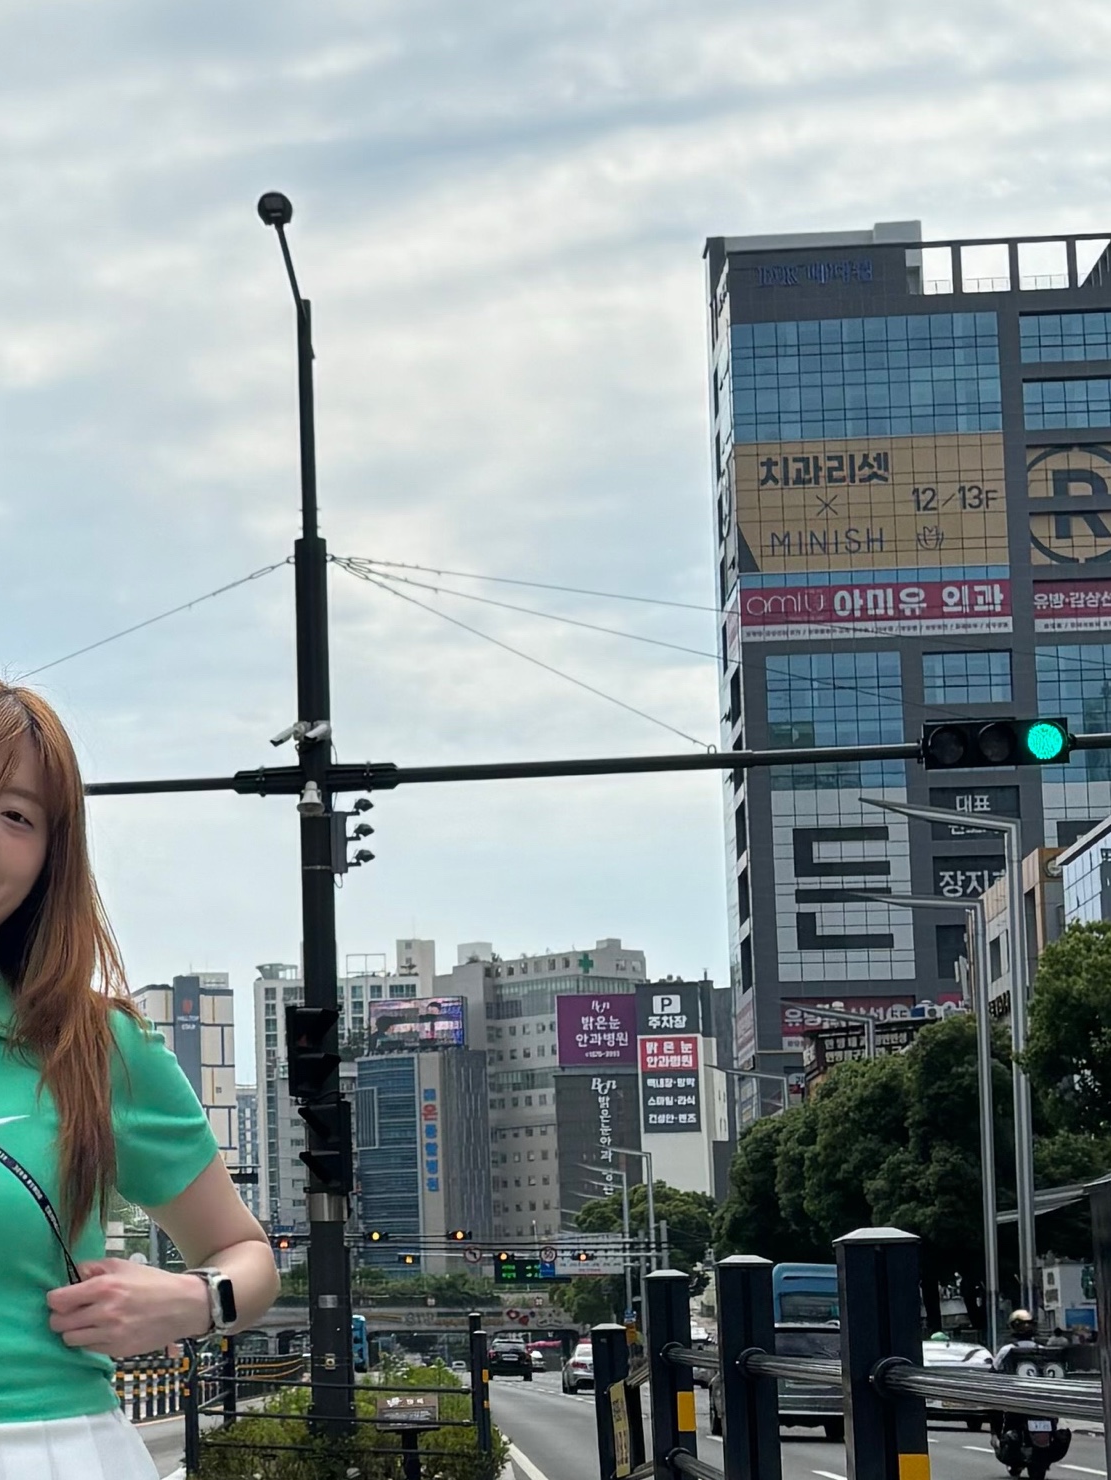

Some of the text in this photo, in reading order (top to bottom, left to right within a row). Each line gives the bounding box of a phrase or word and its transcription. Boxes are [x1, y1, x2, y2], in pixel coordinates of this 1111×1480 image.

[760, 452, 890, 487] 치과리셋
[770, 528, 885, 556] MINISH
[833, 587, 927, 618] 아미유
[942, 583, 1004, 614] 외과
[955, 794, 991, 813] 대표
[661, 997, 672, 1012] P
[581, 1015, 621, 1031] 밝은눈
[648, 1015, 687, 1029] 주차장
[575, 1032, 629, 1048] 안과병원
